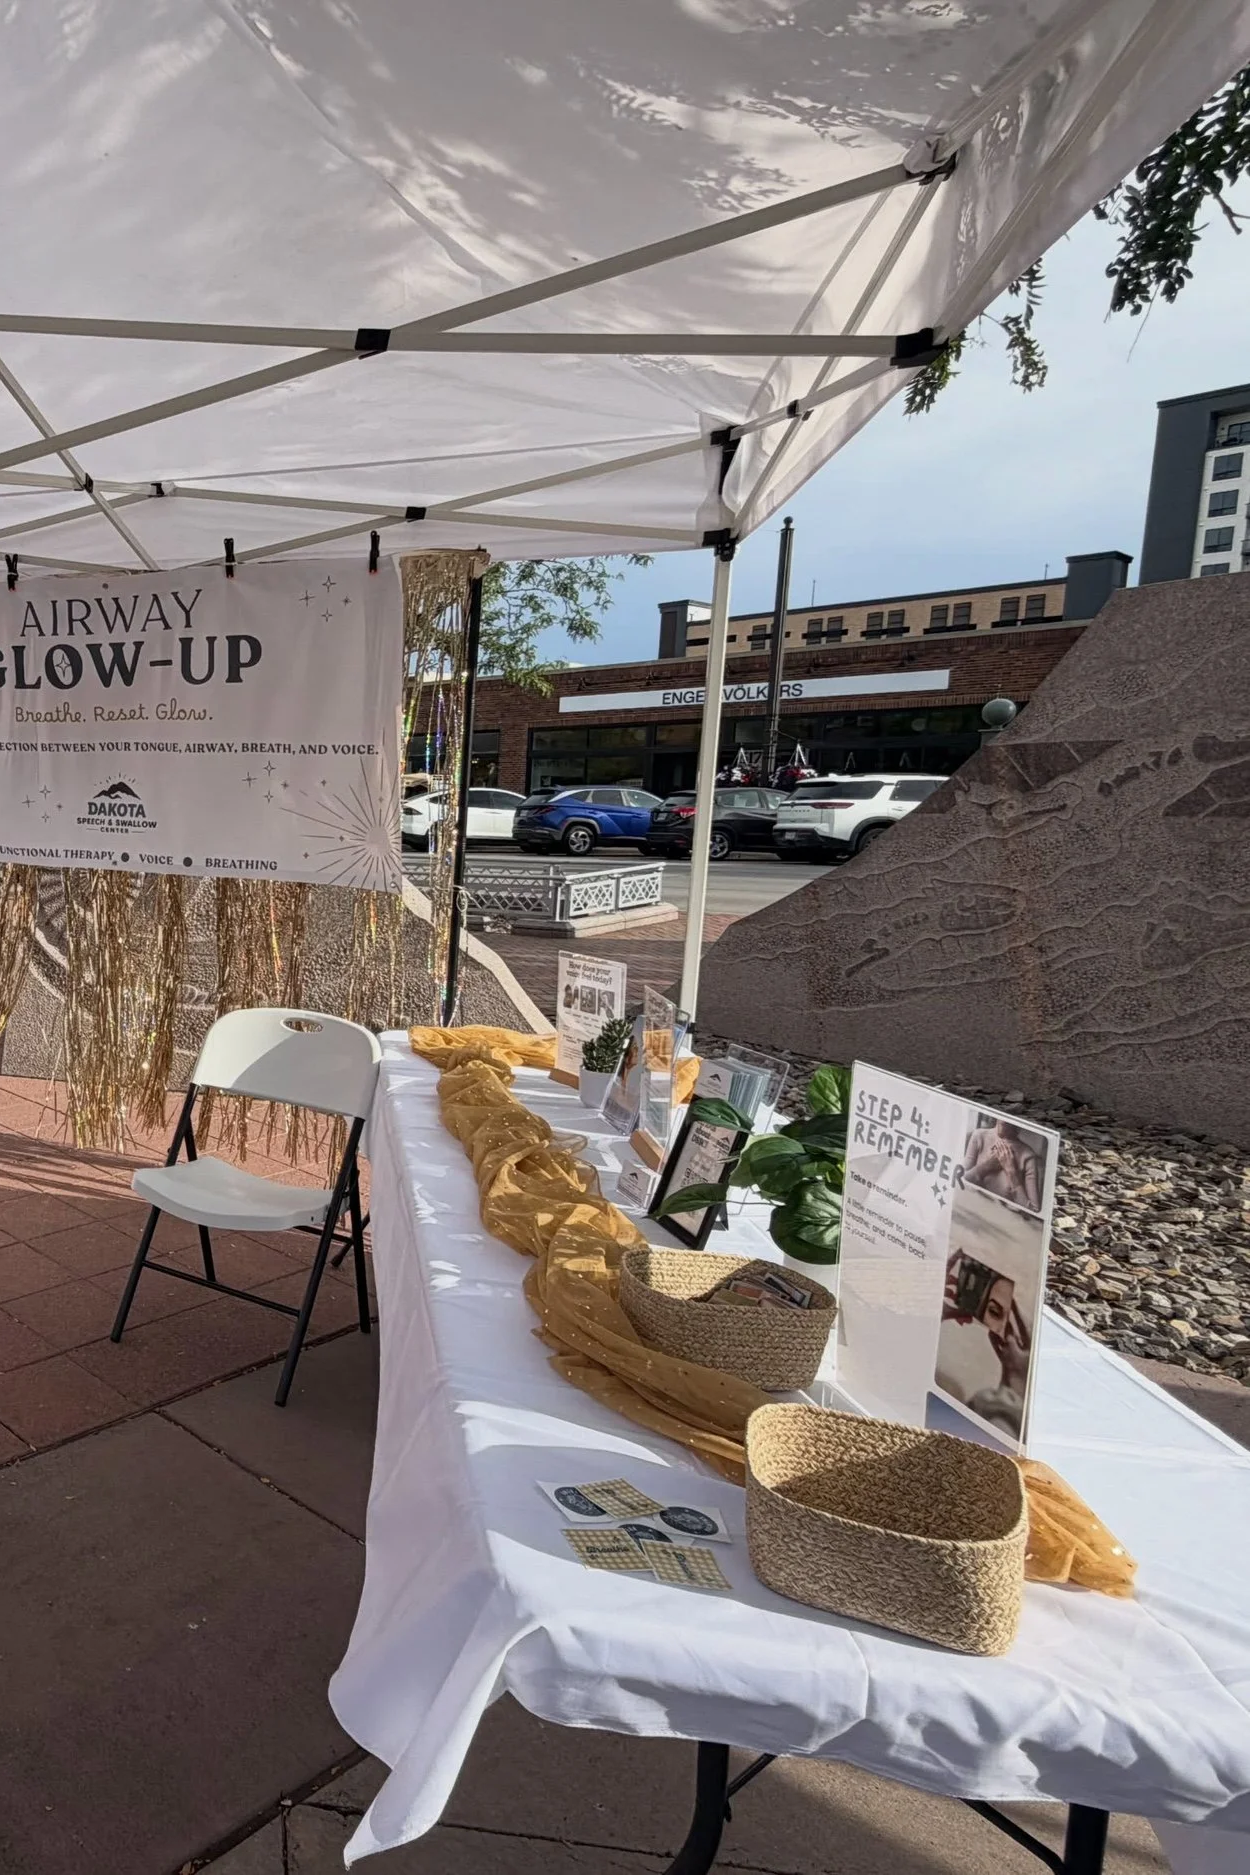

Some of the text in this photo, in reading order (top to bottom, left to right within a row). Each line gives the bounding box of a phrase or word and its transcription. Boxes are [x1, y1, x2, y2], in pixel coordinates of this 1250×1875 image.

[20, 589, 202, 637] AIRWAY
[662, 683, 802, 704] ENGE VÖLKRS
[16, 698, 213, 723] Breathe. Reset. Glow.
[41, 743, 96, 752] BETWEEN
[99, 742, 131, 752] YOUR
[134, 742, 182, 753] TONGUE,
[241, 743, 295, 755] BREATH,
[298, 744, 328, 755] AND
[332, 745, 379, 755] VOICE.
[88, 802, 146, 818] DAKOTA
[116, 819, 157, 828] SWALLOW
[63, 849, 114, 860] THERAPY
[139, 854, 173, 865] VOICE
[205, 858, 278, 870] BREATHING
[856, 1090, 930, 1137] STEP 4:
[854, 1121, 965, 1190] REMEMBER
[851, 1171, 866, 1185] Take
[867, 1181, 872, 1189] a
